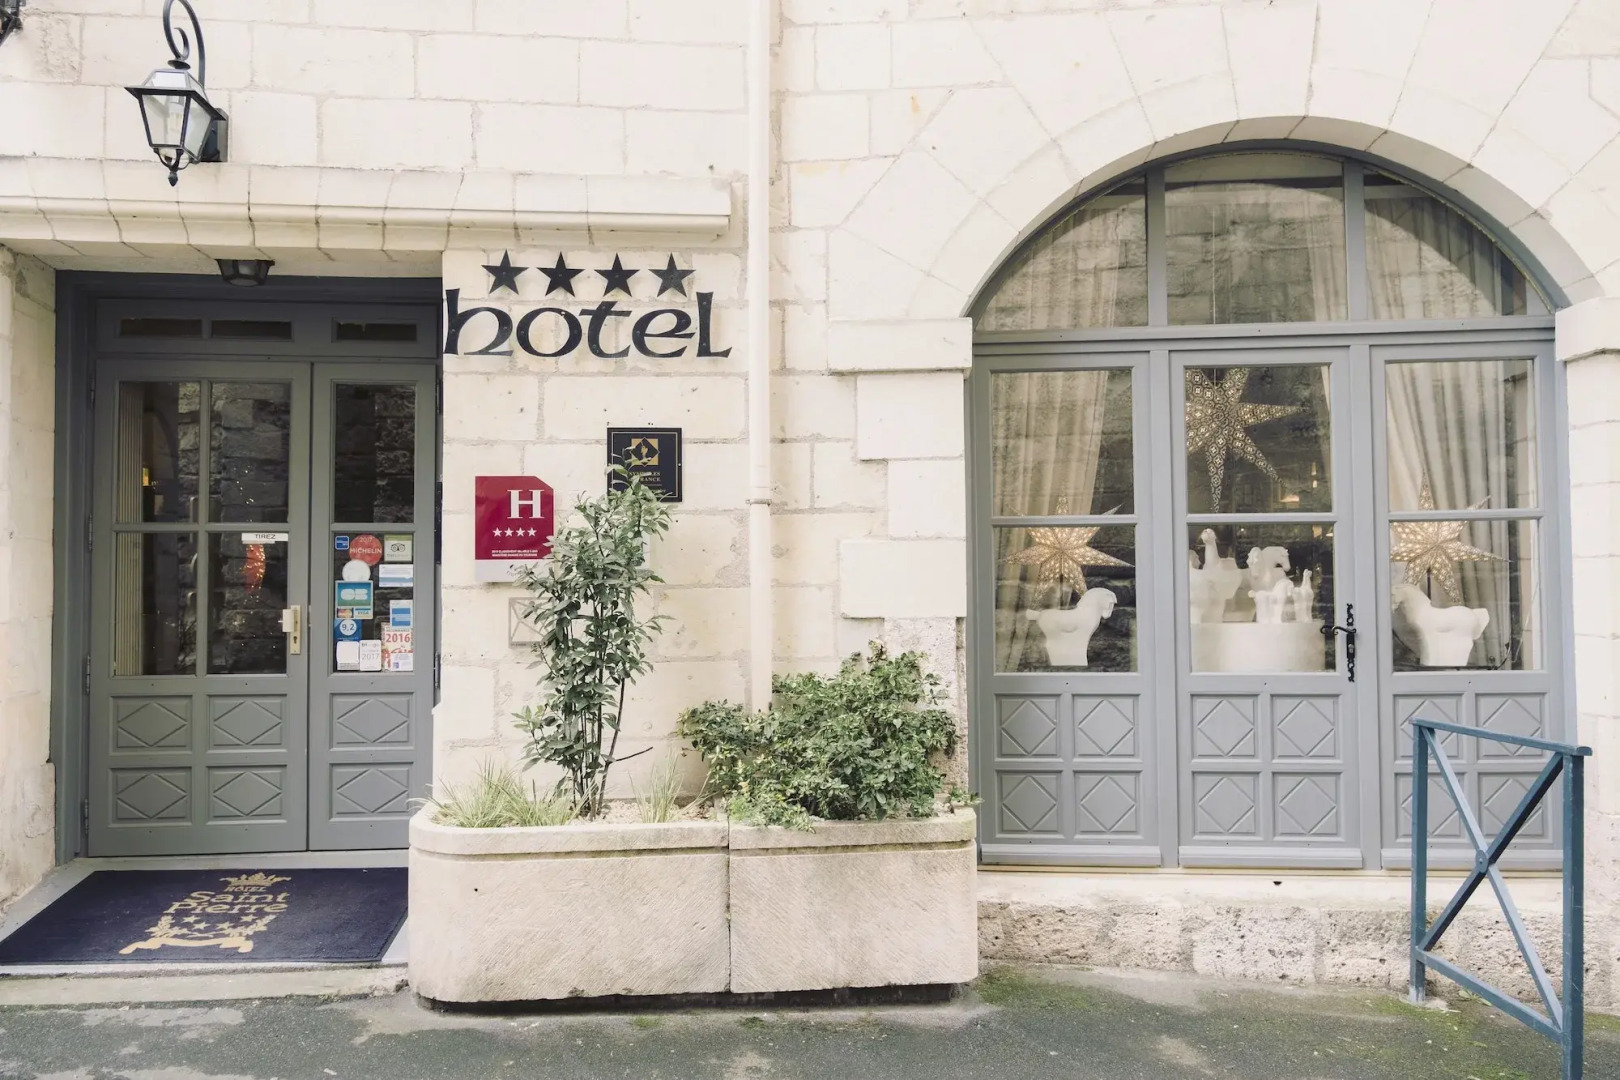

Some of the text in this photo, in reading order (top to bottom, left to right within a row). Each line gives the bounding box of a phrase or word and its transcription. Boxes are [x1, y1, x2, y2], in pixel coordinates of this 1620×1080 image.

[443, 288, 732, 359] hotel
[507, 489, 545, 519] H
[385, 633, 411, 643] 2016
[183, 890, 291, 903] Saint
[163, 901, 289, 914] Pierre
